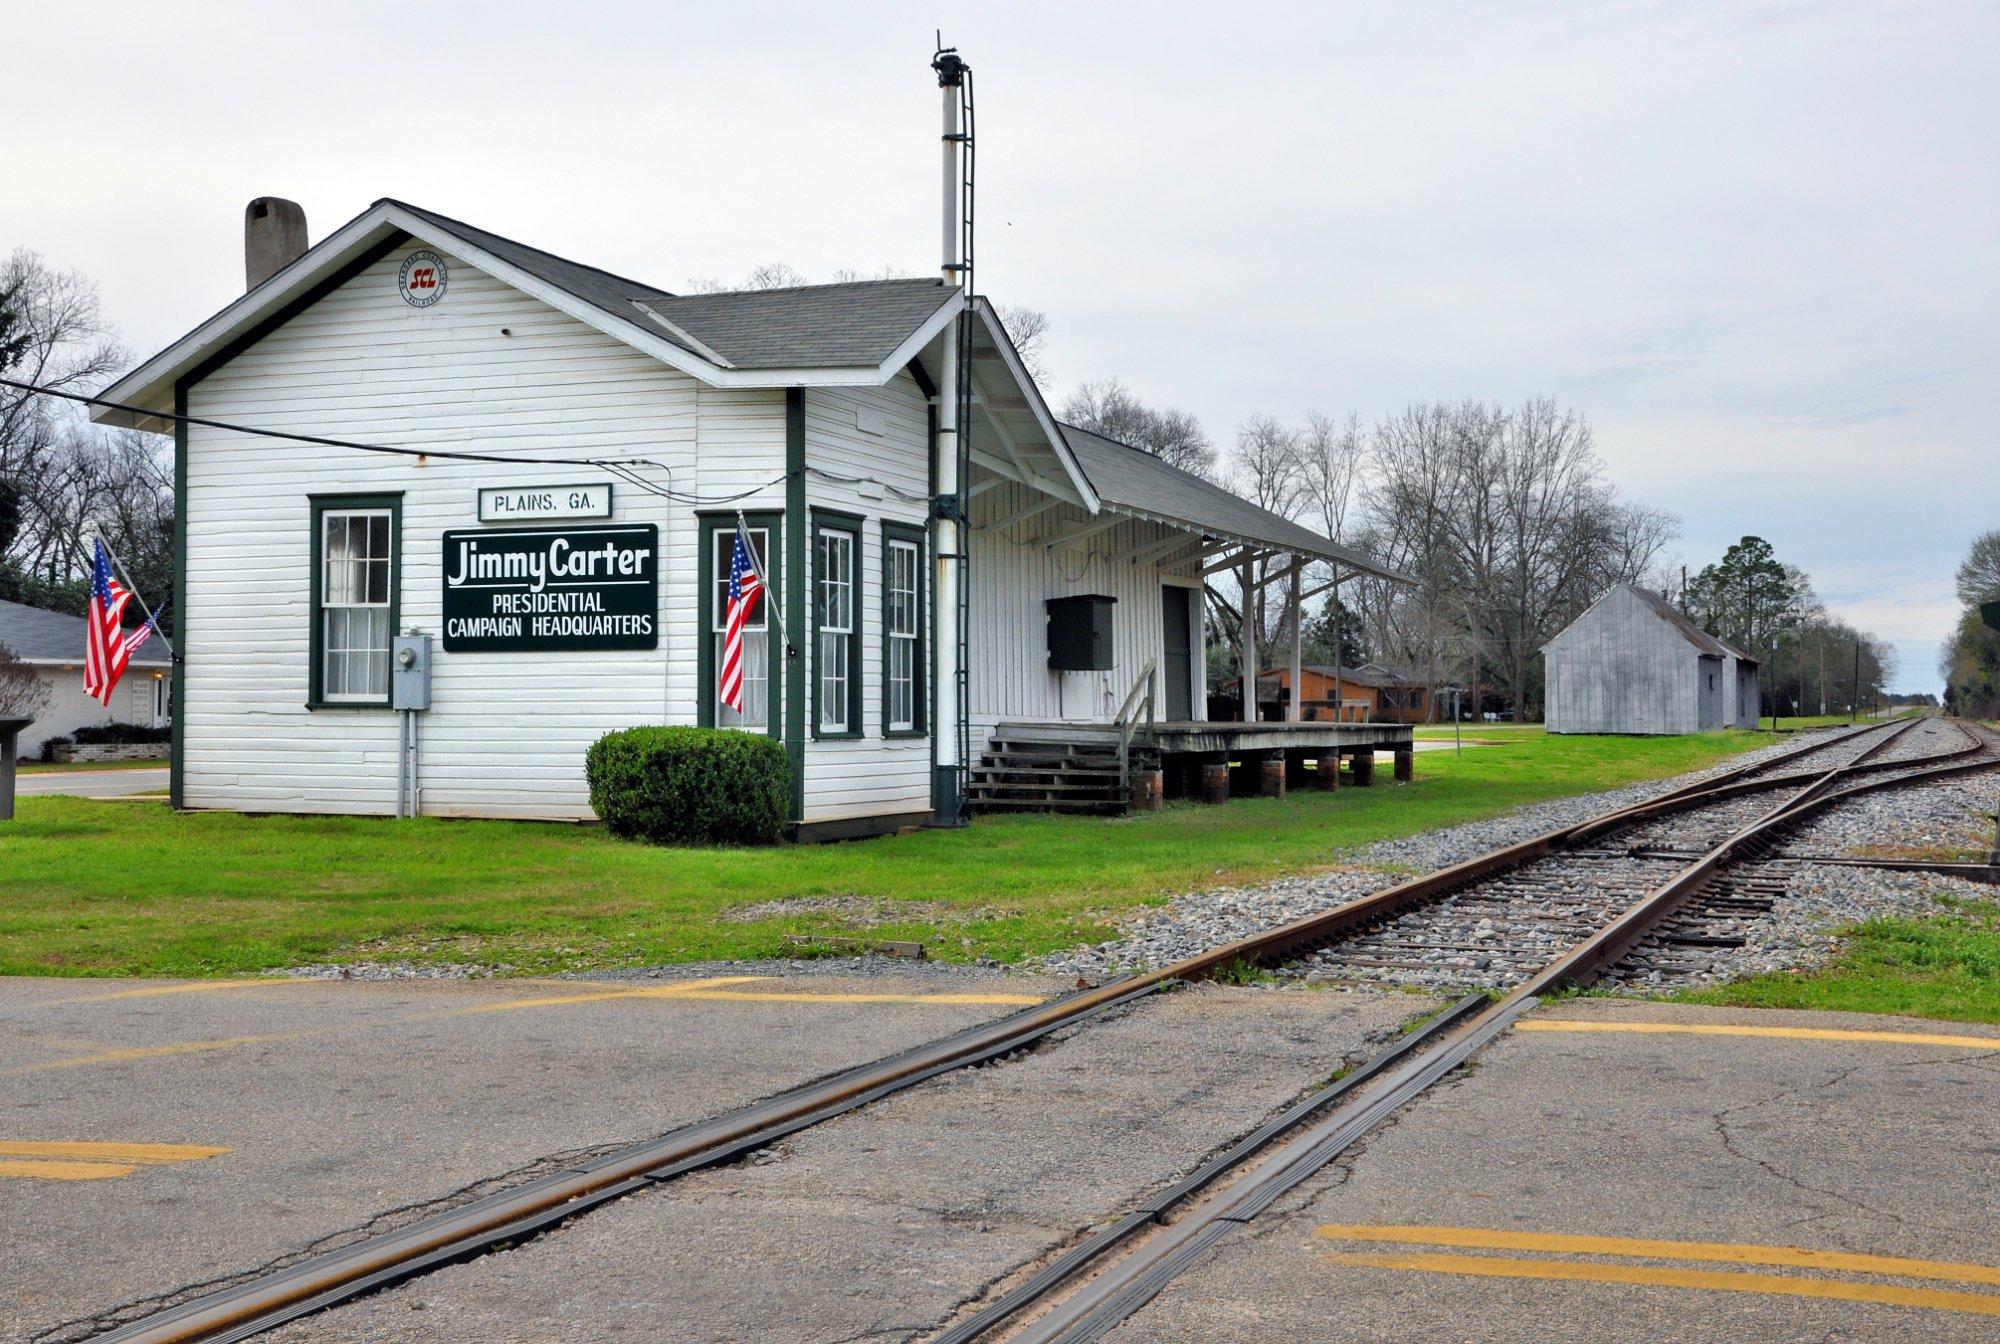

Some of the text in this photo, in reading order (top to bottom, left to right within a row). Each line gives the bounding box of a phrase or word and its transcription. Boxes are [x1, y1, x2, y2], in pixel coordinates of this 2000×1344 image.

[409, 268, 436, 289] SCL
[569, 492, 595, 509] GA.
[447, 538, 650, 593] Jimmy Carter
[493, 592, 606, 614] PRESIDENTIAL
[447, 614, 652, 638] CAMPAIGN HEADQUARTERS
